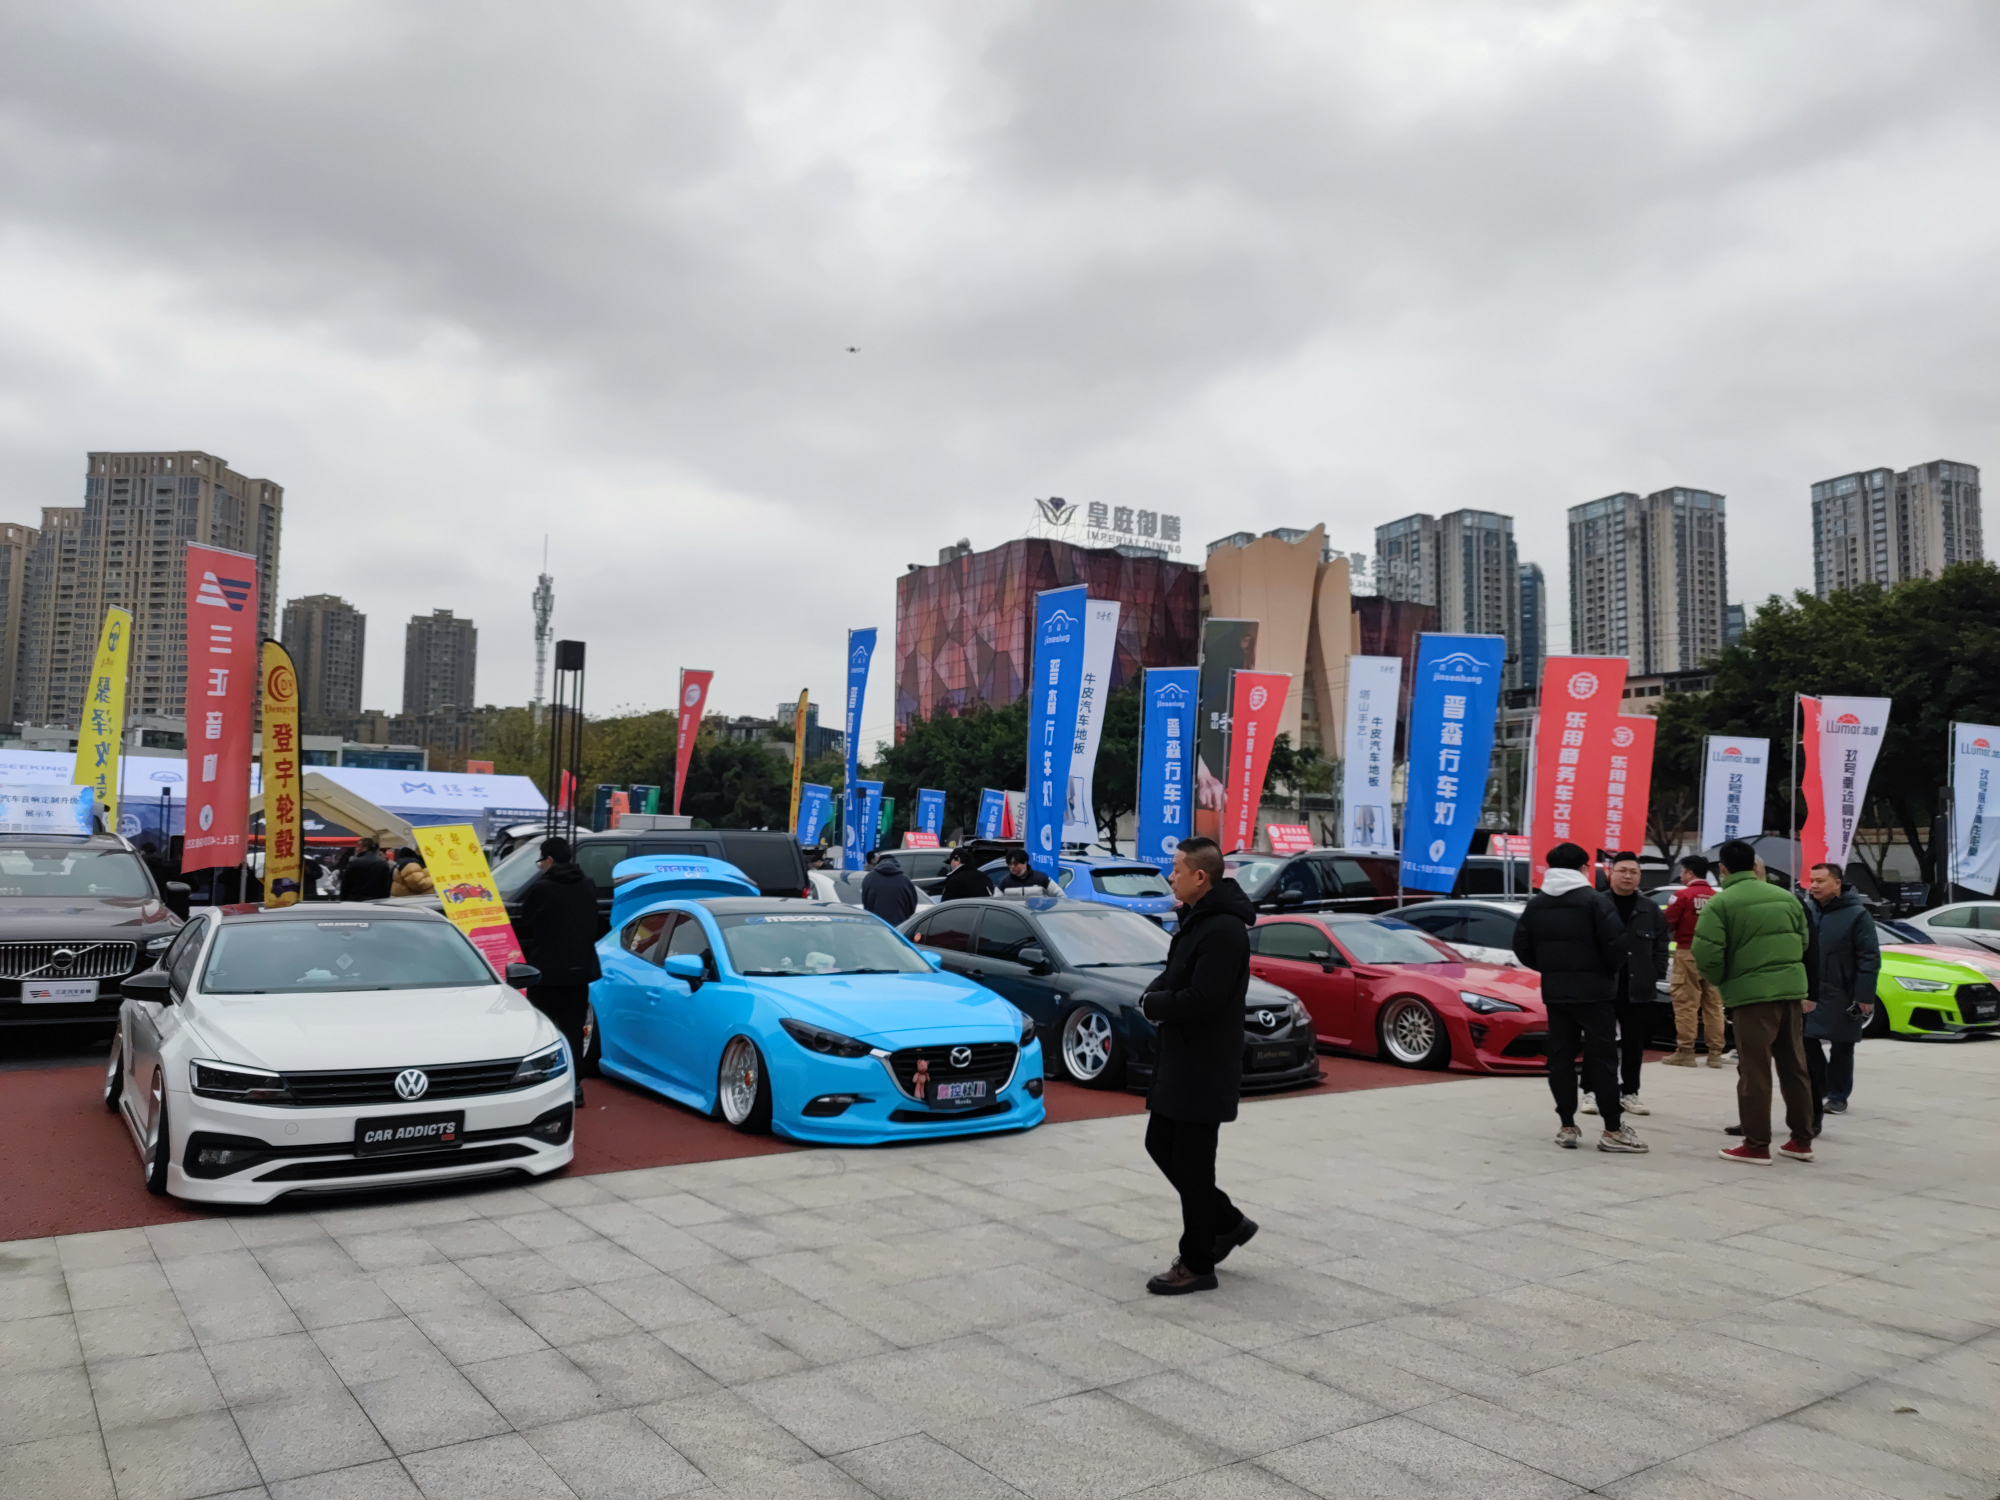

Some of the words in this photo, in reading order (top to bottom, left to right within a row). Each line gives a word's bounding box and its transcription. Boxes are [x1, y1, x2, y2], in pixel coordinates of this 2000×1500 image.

[1087, 530, 1139, 547] IMPERIAL
[1144, 540, 1181, 554] DINING
[1088, 501, 1181, 542] 皇庭御膳
[1073, 673, 1096, 755] 牛皮汽车地板
[1367, 716, 1384, 788] 牛皮汽车地板
[271, 723, 296, 860] 登宇轮毂
[1163, 718, 1182, 825] 晋森行车灯
[1434, 695, 1467, 826] 晋森行车灯
[1553, 711, 1588, 839] 乐用商务车改装
[25, 810, 54, 818] 展示车
[1605, 755, 1628, 850] 乐用商务车改装
[364, 1129, 393, 1143] CAR
[395, 1122, 456, 1139] ADDICTS
